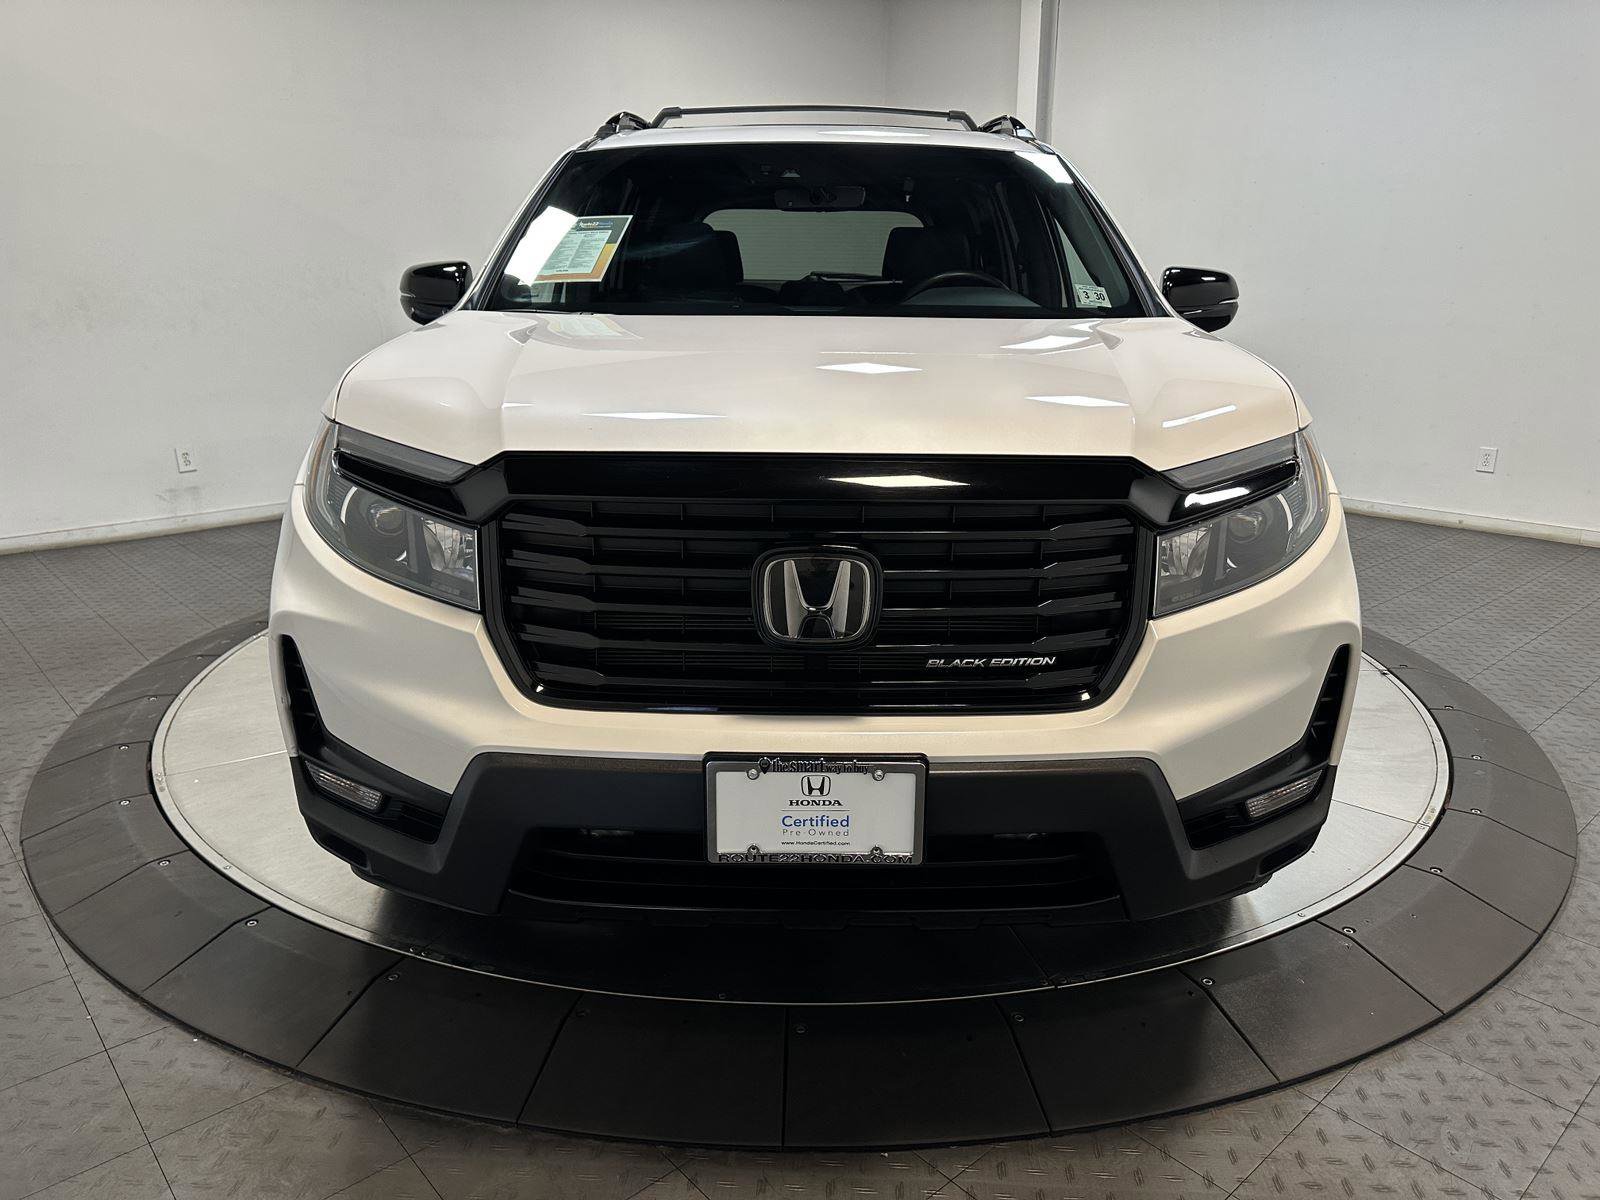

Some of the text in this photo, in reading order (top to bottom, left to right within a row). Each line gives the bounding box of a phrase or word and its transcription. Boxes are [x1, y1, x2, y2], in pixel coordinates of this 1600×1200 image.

[1094, 292, 1106, 301] 30
[926, 657, 1056, 667] BLACK EDITION
[781, 814, 850, 827] Certified
[718, 854, 913, 863] ROUTE22HONDA.COM
